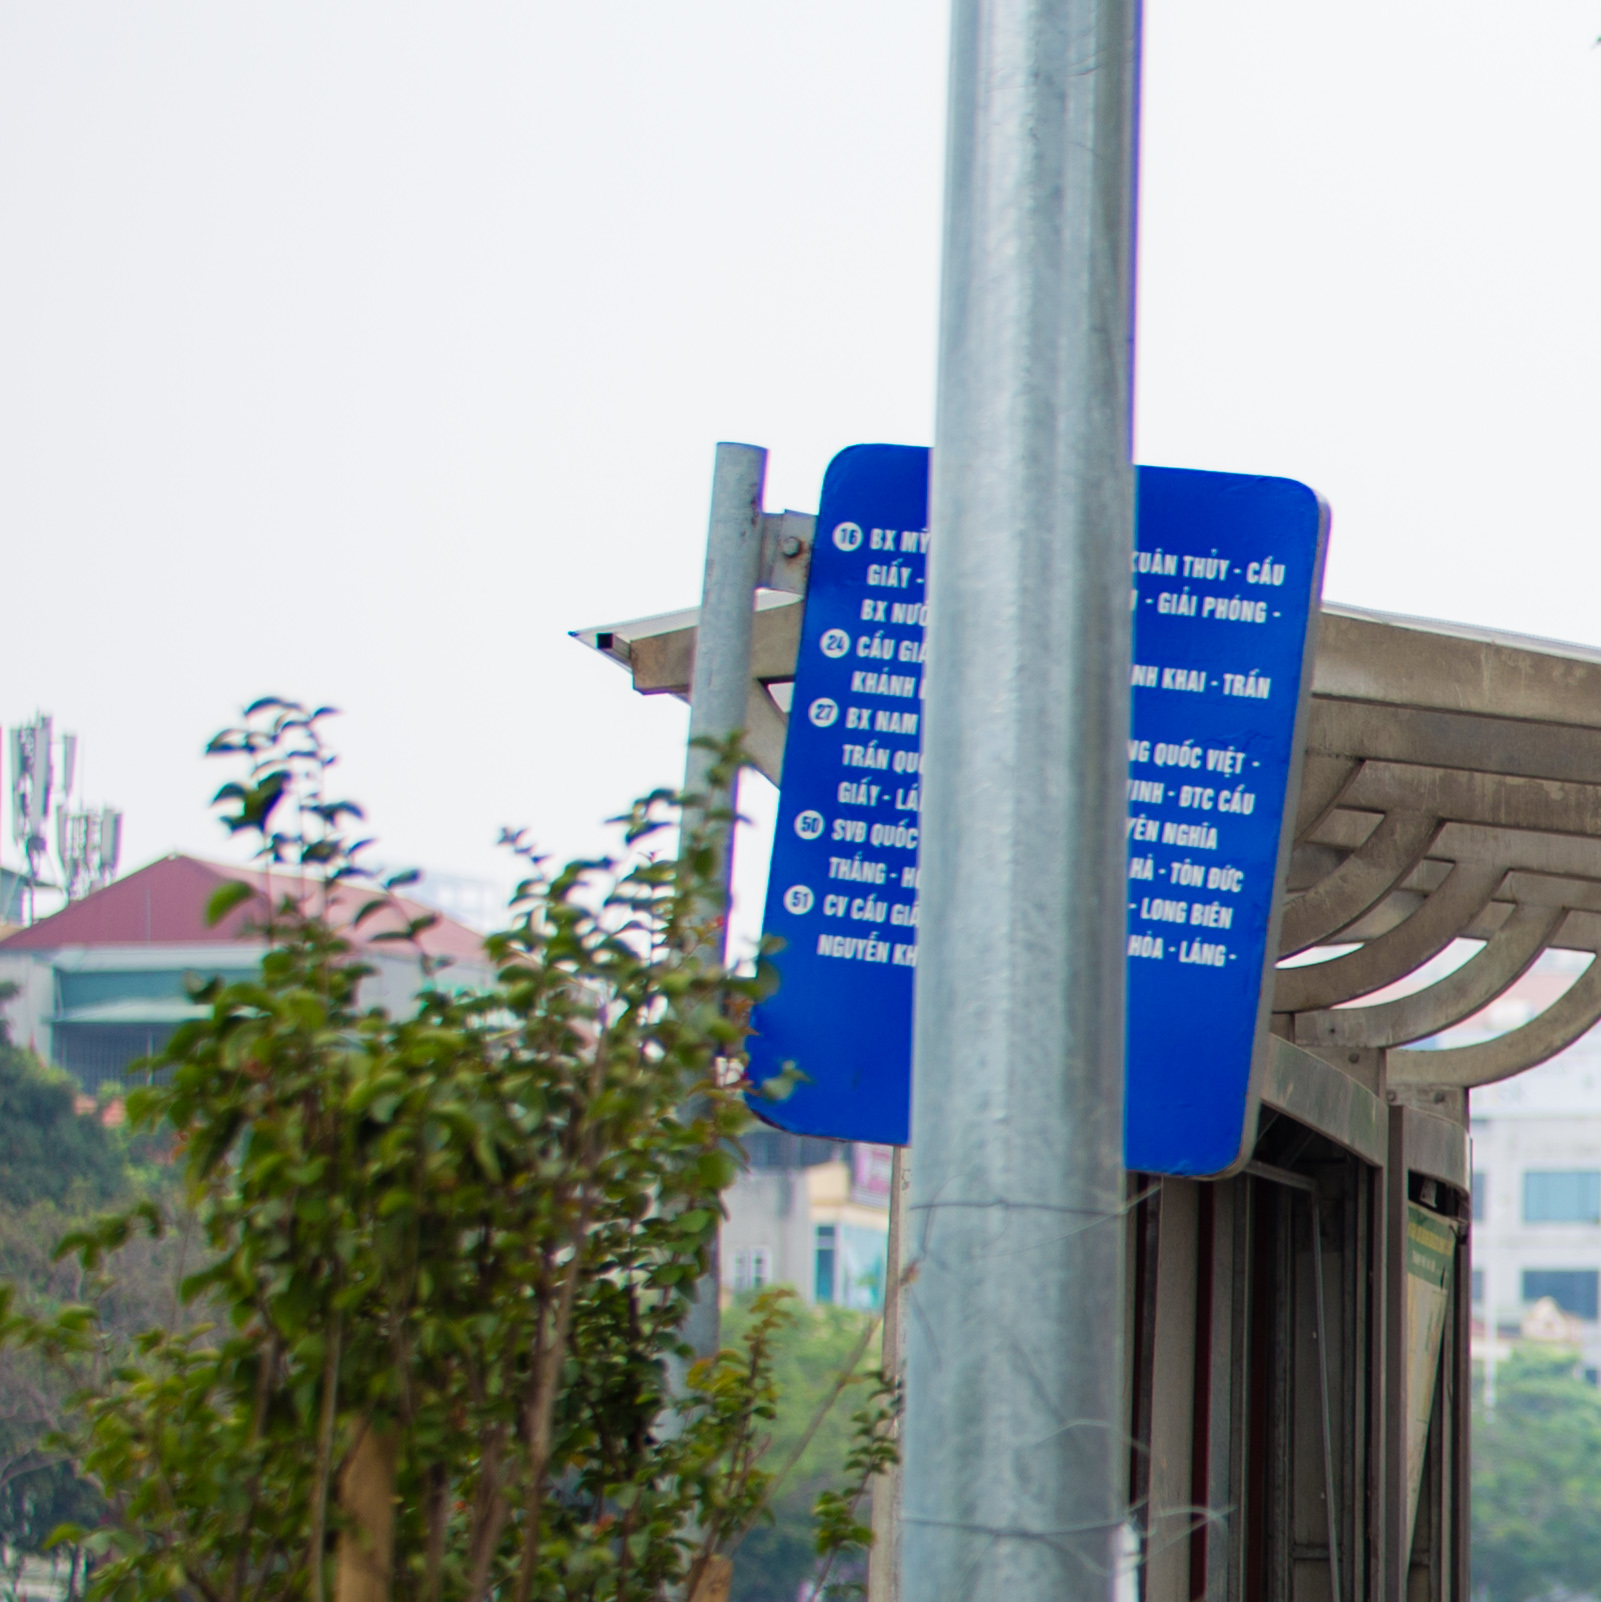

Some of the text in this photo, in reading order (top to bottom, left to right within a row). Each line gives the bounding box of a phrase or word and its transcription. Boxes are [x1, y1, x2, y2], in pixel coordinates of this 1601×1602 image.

[840, 527, 858, 546] 16
[869, 528, 897, 551] BX
[1182, 547, 1230, 581] THỦY
[860, 598, 889, 622] BX
[866, 558, 912, 588] GIẤY
[1157, 585, 1197, 617] GIẢI
[1202, 594, 1268, 624] PHÓNG
[827, 634, 844, 651] 24
[1131, 664, 1159, 688] NH
[1161, 667, 1207, 692] KHAI
[851, 667, 917, 698] KHÁNH
[815, 702, 833, 721] 27
[845, 706, 873, 730] BX
[874, 709, 919, 735] NAM
[1127, 740, 1150, 764] NG
[1153, 739, 1203, 769] QUỐC
[1206, 746, 1246, 778] VIỆT
[837, 776, 881, 807] GIẤY
[895, 783, 922, 812] LÁ
[1162, 821, 1218, 850] NGHĨA
[801, 815, 819, 833] 50
[870, 818, 919, 849] QUỐC
[1128, 853, 1154, 881] HÀ
[1170, 858, 1206, 887] TÔN
[1206, 864, 1245, 893] ĐỨC
[792, 891, 808, 908] 51
[823, 894, 849, 918] CV
[1178, 937, 1226, 967] LÁNG
[1140, 897, 1188, 924] LONG
[1190, 901, 1233, 929] BIÊN
[816, 931, 920, 967] NGUYỄN KH
